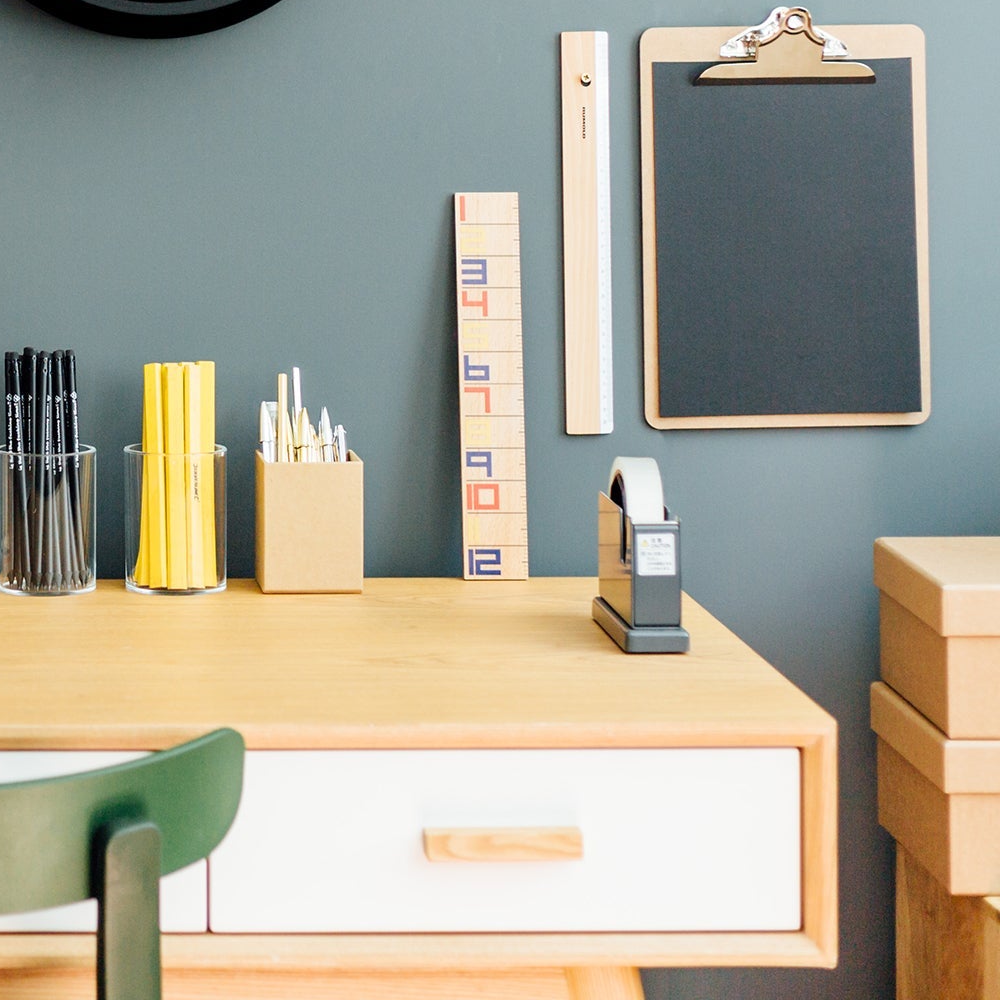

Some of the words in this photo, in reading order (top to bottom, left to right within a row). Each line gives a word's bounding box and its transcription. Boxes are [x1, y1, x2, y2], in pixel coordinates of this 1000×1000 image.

[459, 195, 466, 222] 1
[461, 259, 488, 285] 3
[462, 291, 488, 317] 4
[464, 387, 491, 413] 7
[466, 451, 492, 478] 9
[466, 483, 500, 511] 10
[468, 548, 502, 576] 12
